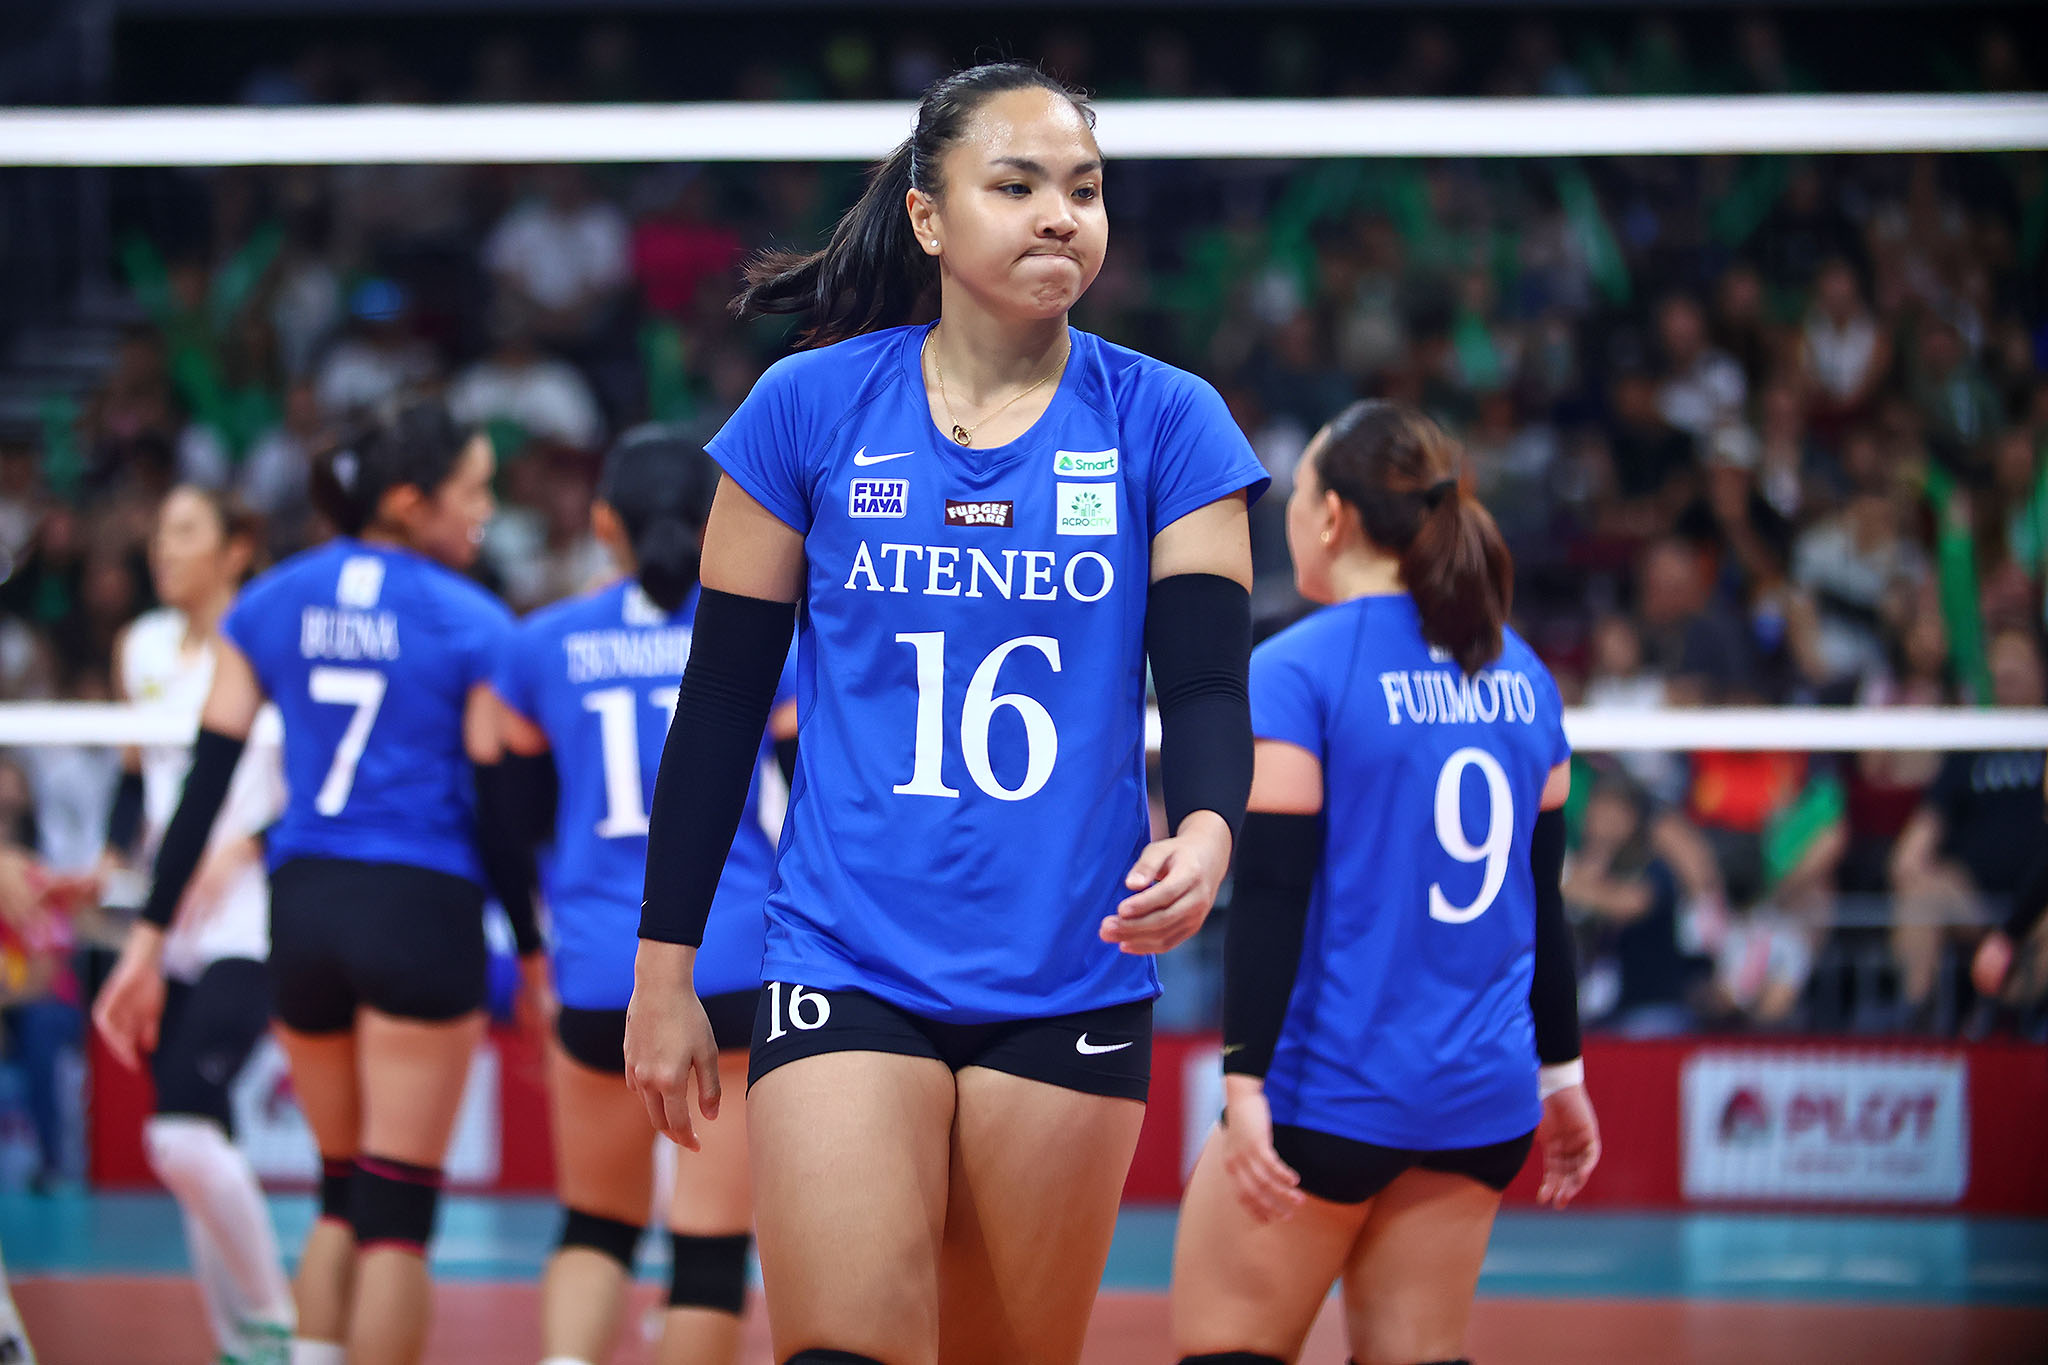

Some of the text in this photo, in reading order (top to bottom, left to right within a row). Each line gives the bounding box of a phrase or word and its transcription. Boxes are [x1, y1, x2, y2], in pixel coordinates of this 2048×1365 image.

[1075, 457, 1115, 470] Smart
[853, 498, 903, 513] HAYA
[855, 482, 903, 497] FUJI
[947, 503, 1009, 519] FUDGEE
[965, 513, 1006, 526] BARR
[1062, 517, 1111, 526] ACROCITY
[844, 540, 1115, 602] ATENEO
[1379, 670, 1536, 725] FUJIMOTO
[892, 631, 1062, 801] 16
[308, 667, 388, 816] 7
[1428, 747, 1515, 924] 9
[766, 981, 831, 1043] 16
